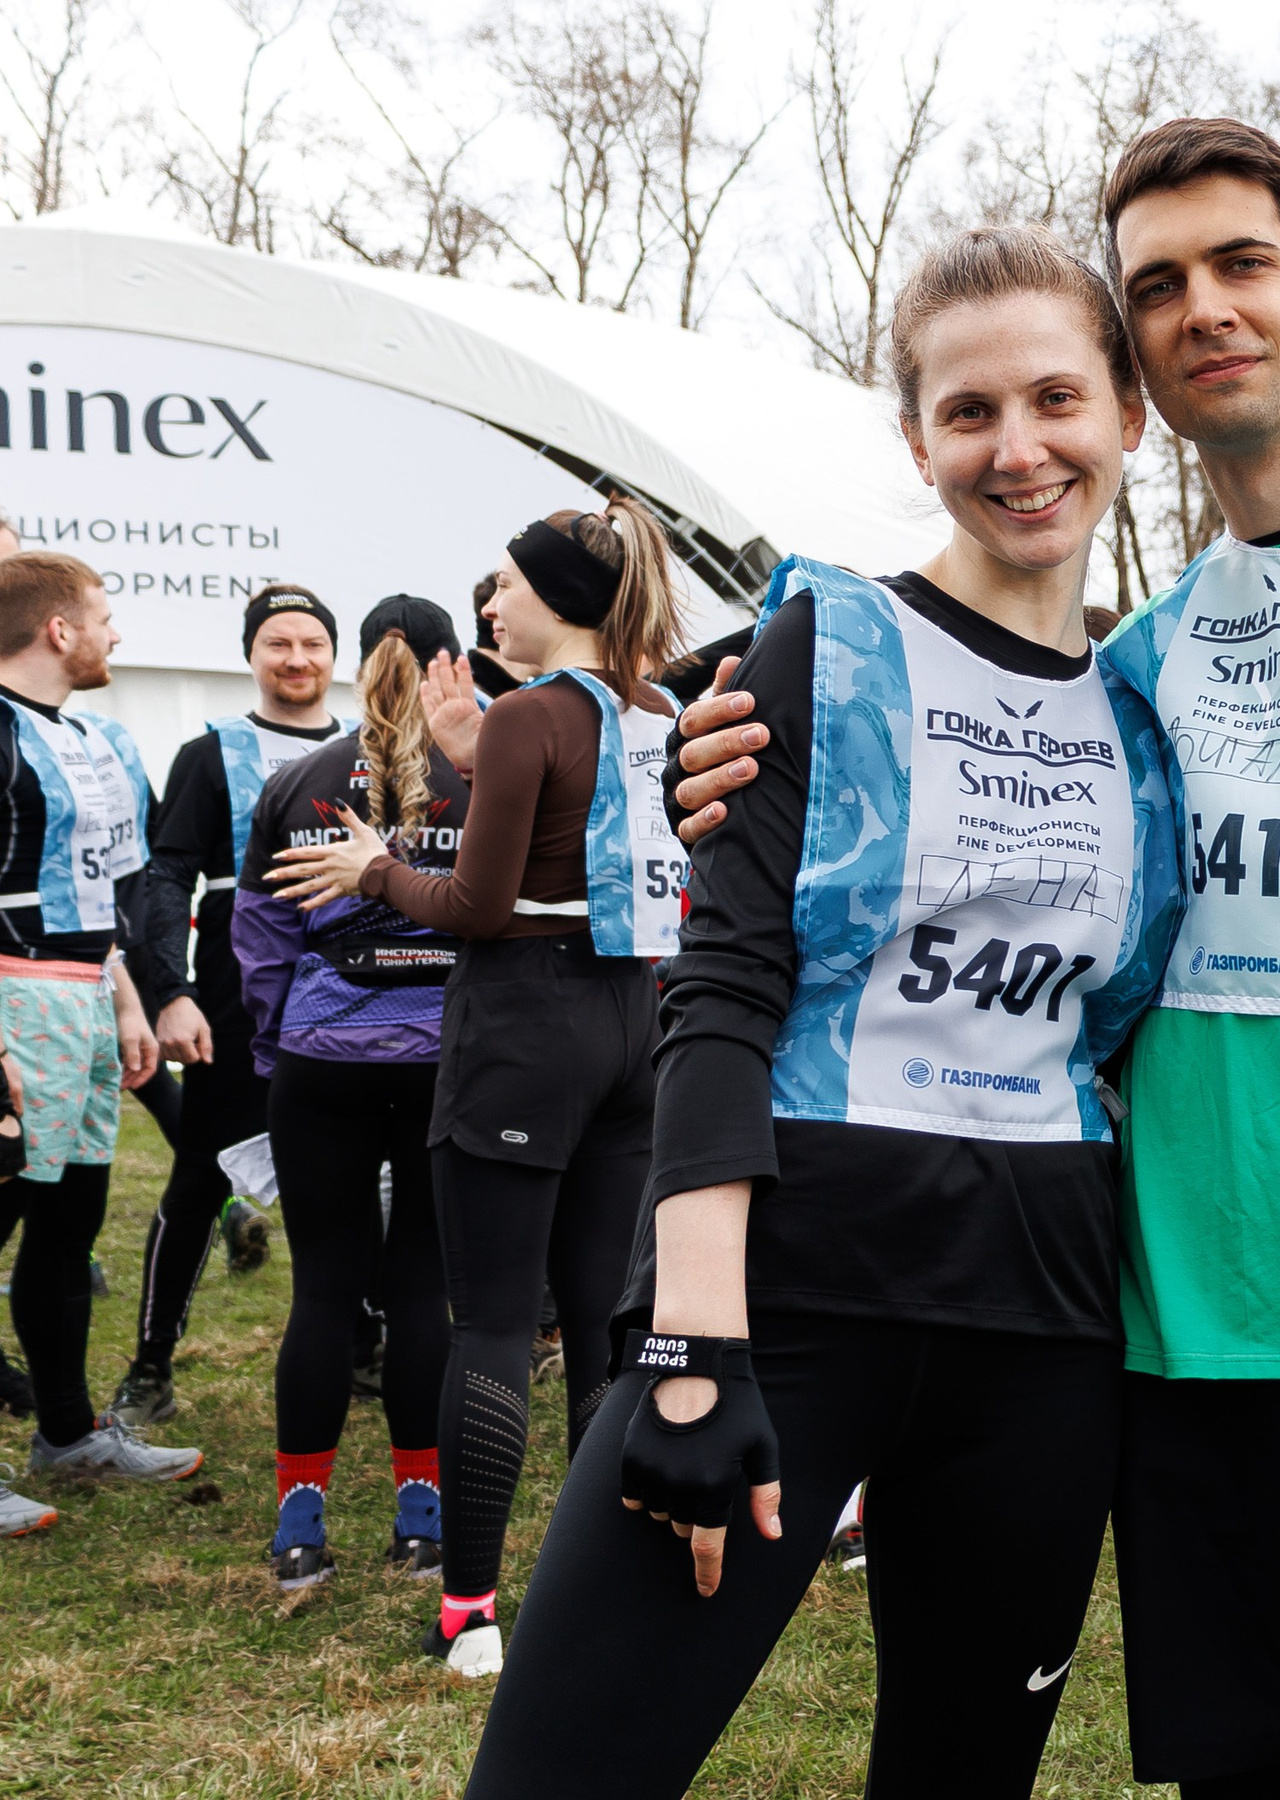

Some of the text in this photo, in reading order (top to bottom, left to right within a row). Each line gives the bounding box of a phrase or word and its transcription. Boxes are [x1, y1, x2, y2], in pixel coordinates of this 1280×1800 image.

[0, 361, 274, 462] inex
[102, 571, 281, 598] OPMEN
[1192, 608, 1268, 637] ГОНКА
[1192, 709, 1233, 725] FINE
[927, 708, 1116, 761] ГОНКА ГЕРОЕВ
[629, 747, 666, 763] ГОНК
[959, 760, 1098, 808] Sminex
[958, 814, 1101, 837] ПЕРФЕКЦИОНИСТЫ
[957, 835, 1102, 855] FINE DEVELOPMENT
[646, 860, 690, 899] 53
[935, 855, 1107, 917] ЛЕНА
[376, 958, 413, 966] ГОНКА
[898, 923, 1097, 1022] 5401
[941, 1067, 1041, 1095] ГАЗПРОМБАНК
[645, 1338, 687, 1352] GURU
[637, 1351, 688, 1367] SPORT
